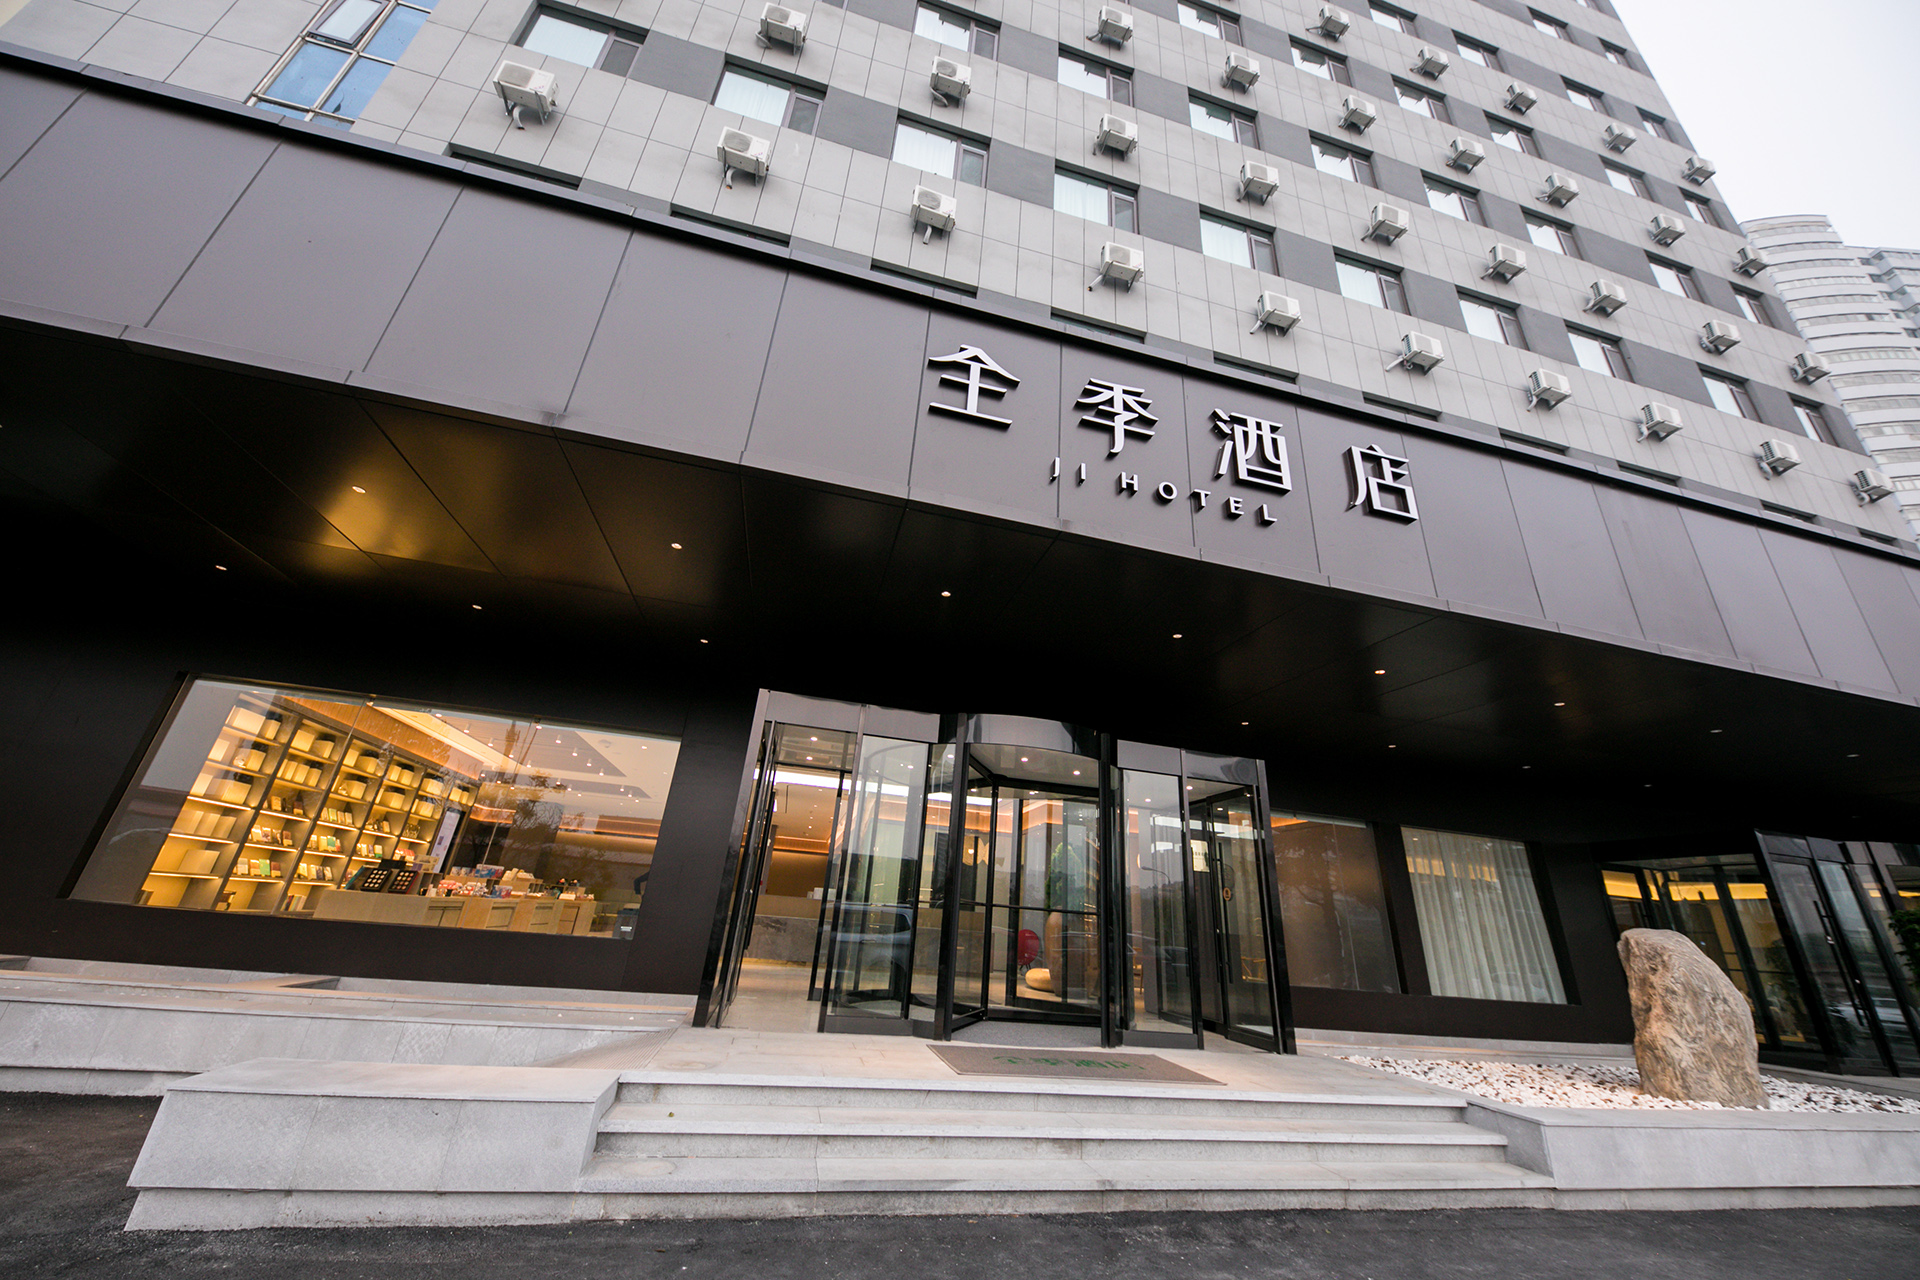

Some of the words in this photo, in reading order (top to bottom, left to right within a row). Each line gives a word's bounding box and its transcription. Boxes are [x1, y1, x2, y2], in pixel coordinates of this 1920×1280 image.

[928, 344, 1419, 524] 全季酒店
[1118, 470, 1278, 526] HOTEL
